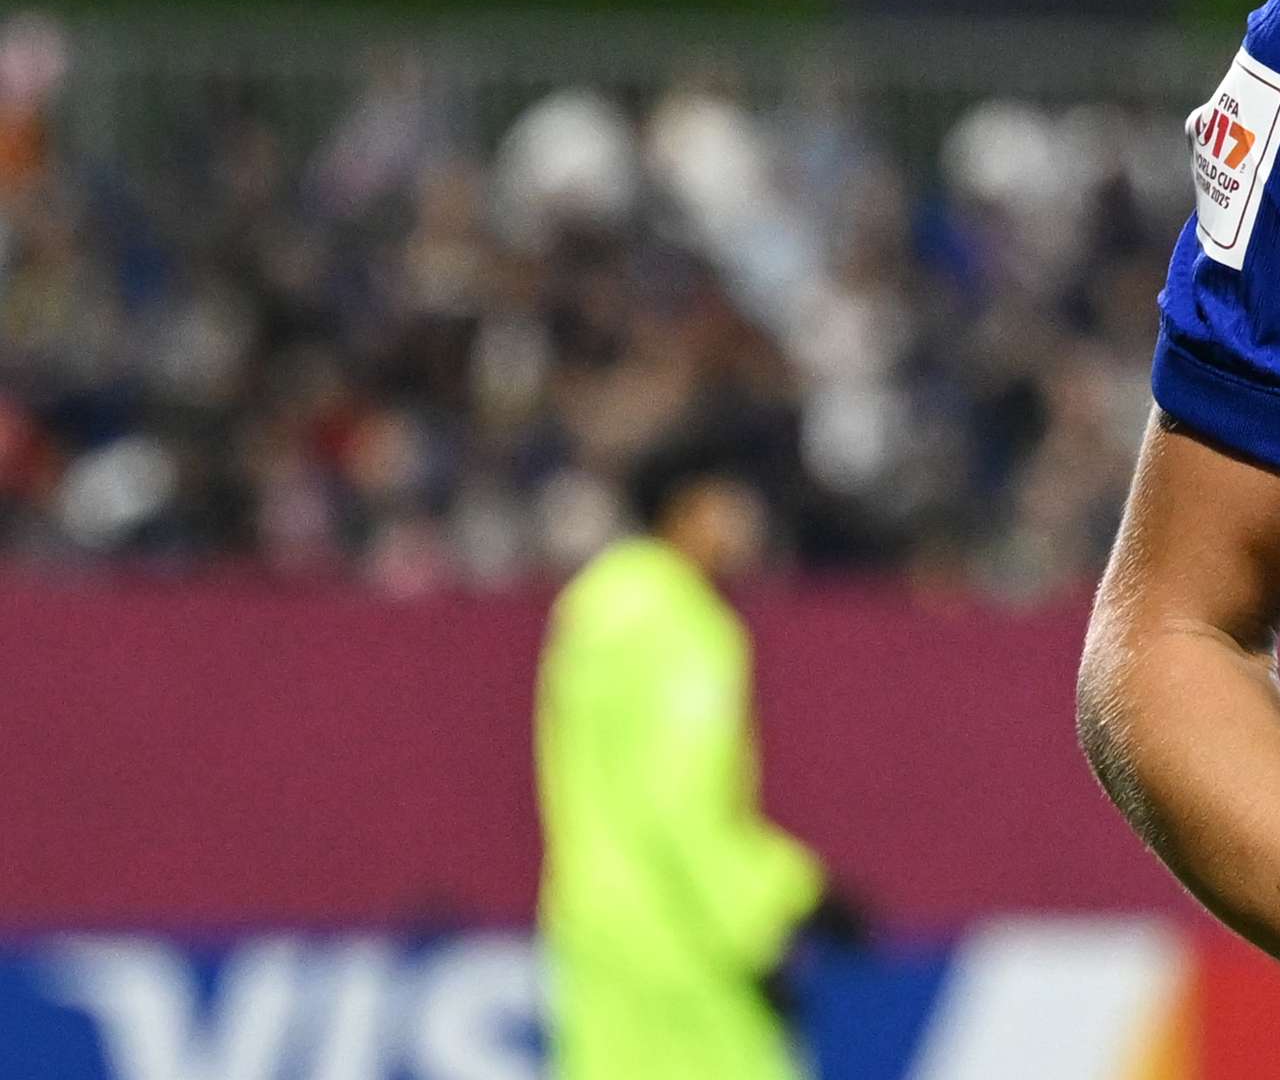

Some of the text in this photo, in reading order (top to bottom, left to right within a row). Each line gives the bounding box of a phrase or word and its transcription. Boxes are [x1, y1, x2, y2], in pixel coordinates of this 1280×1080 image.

[1218, 93, 1240, 118] FIFA
[1197, 154, 1217, 181] ORLD
[1218, 172, 1240, 194] CUP
[1210, 186, 1231, 210] 2025
[50, 933, 545, 1080] VIS
